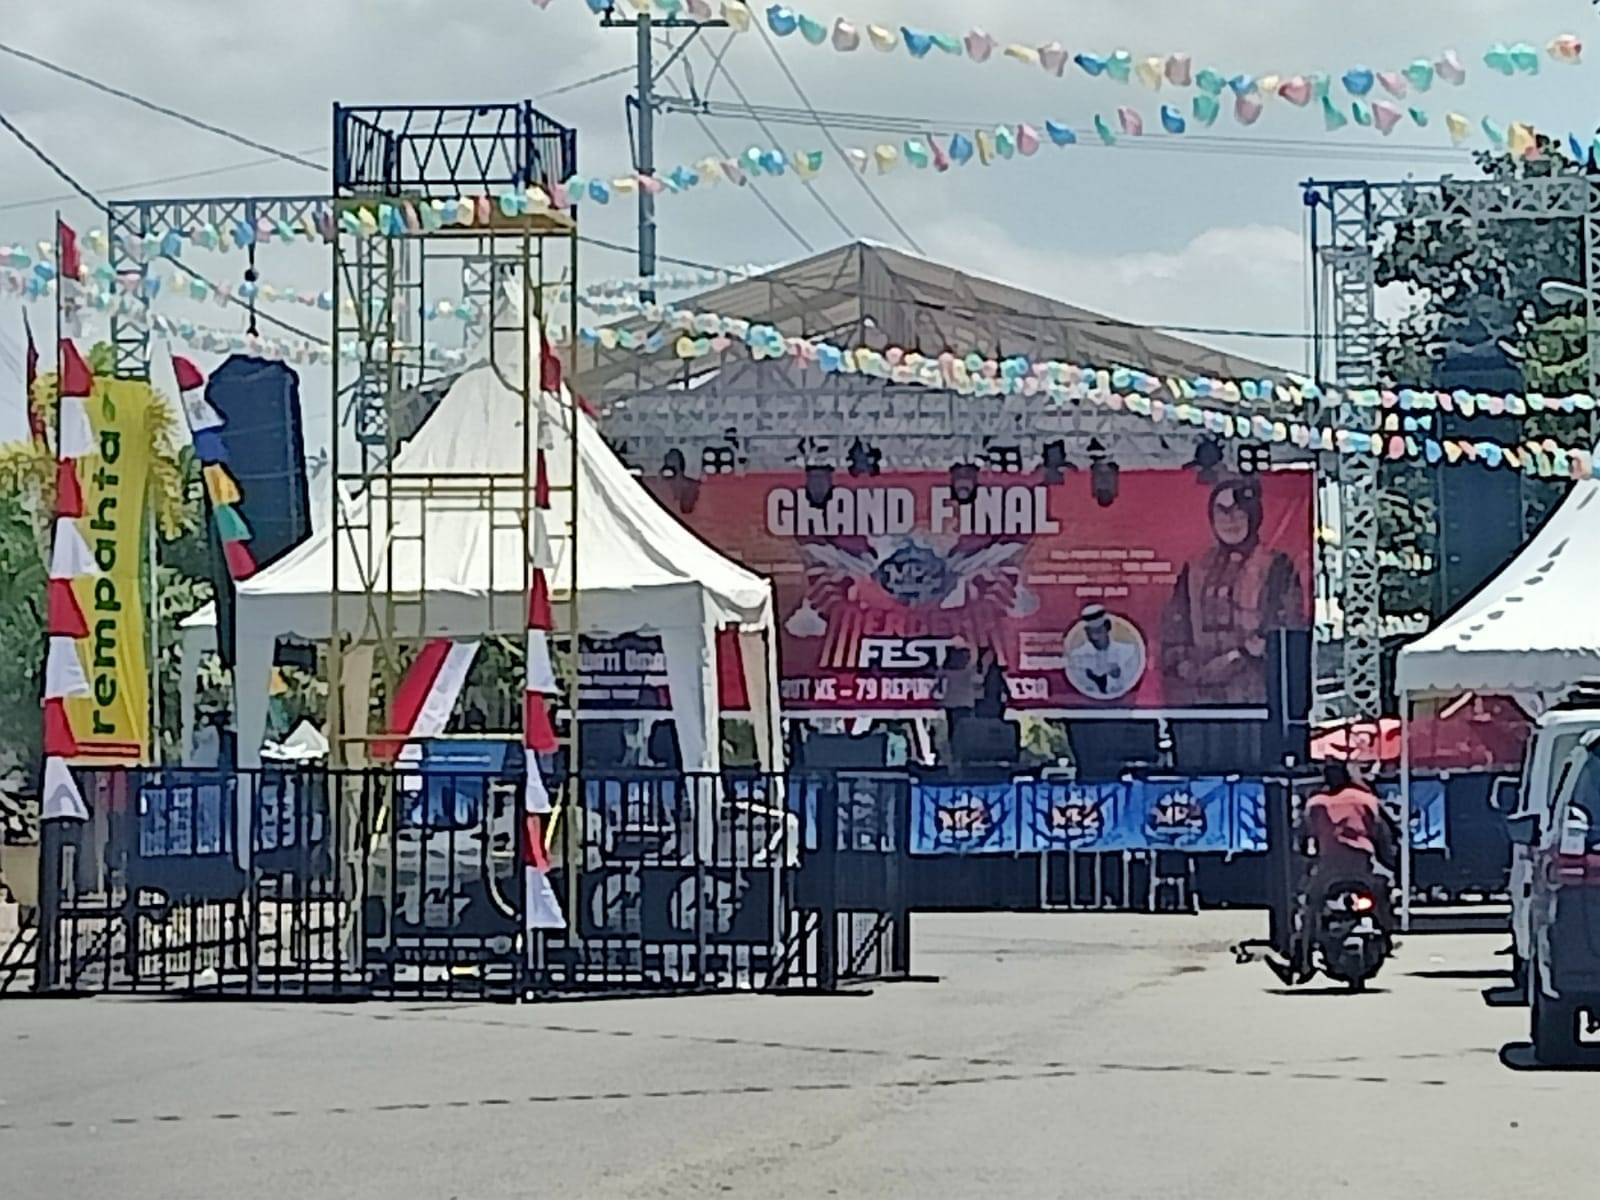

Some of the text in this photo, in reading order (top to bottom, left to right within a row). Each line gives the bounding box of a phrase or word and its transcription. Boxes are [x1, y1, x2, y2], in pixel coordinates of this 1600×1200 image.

[766, 486, 1060, 536] GRAND FINAL
[91, 430, 121, 735] rempahta
[858, 637, 955, 668] FEST
[856, 677, 878, 701] 79
